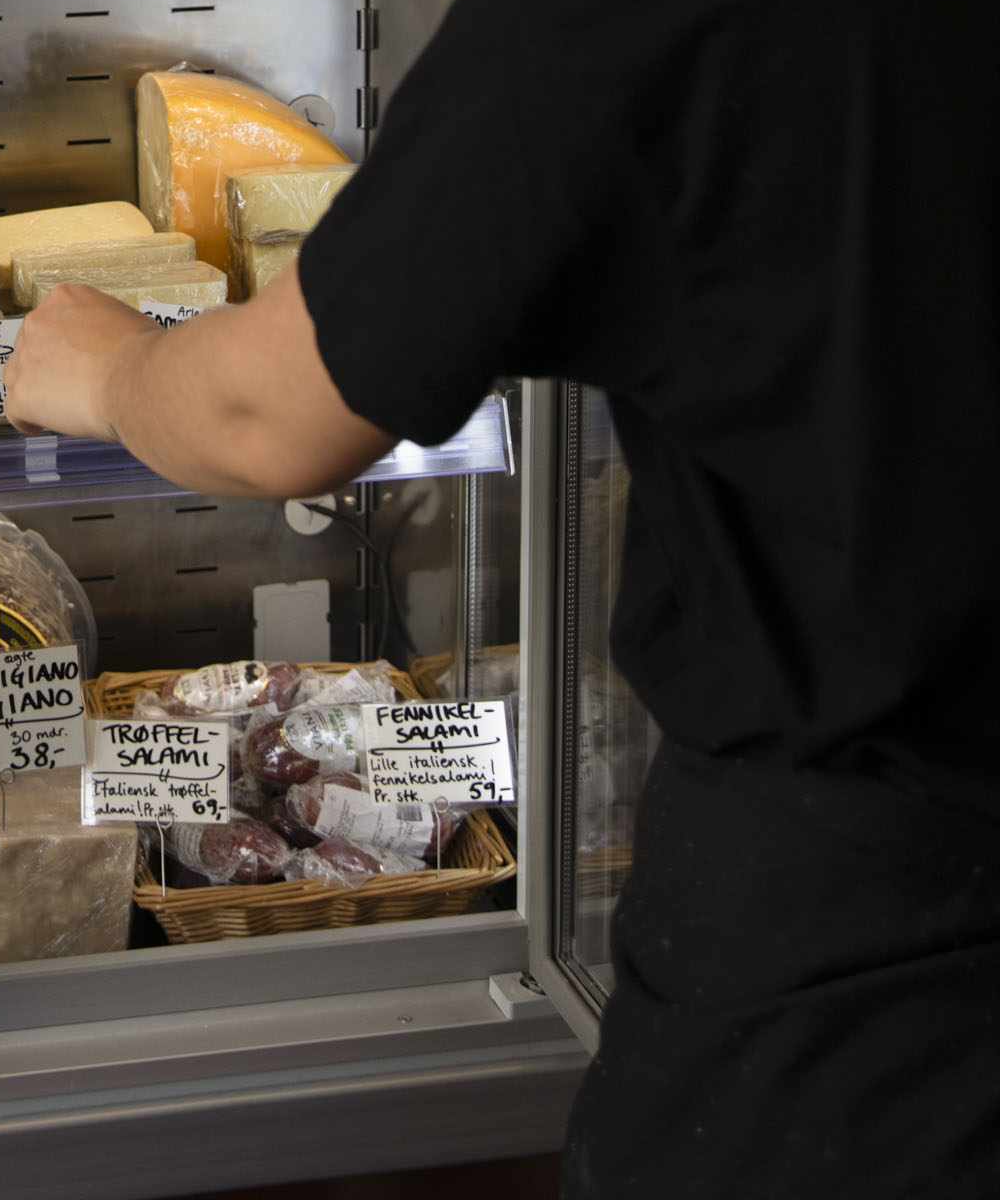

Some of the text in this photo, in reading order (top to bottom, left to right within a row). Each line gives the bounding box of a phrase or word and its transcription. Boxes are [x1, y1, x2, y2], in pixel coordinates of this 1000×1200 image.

[376, 703, 495, 726] FENNIKEL-
[10, 730, 31, 746] 30
[37, 727, 68, 740] mdr.
[102, 724, 220, 745] TRØFFEL-
[396, 724, 479, 743] SALAMI
[10, 742, 65, 769] 38,-
[117, 747, 208, 767] SALAMI
[371, 755, 476, 771] Lille italiensk
[92, 777, 158, 797] Italiensk
[469, 781, 511, 804] 59,-
[192, 799, 226, 820] 69,-
